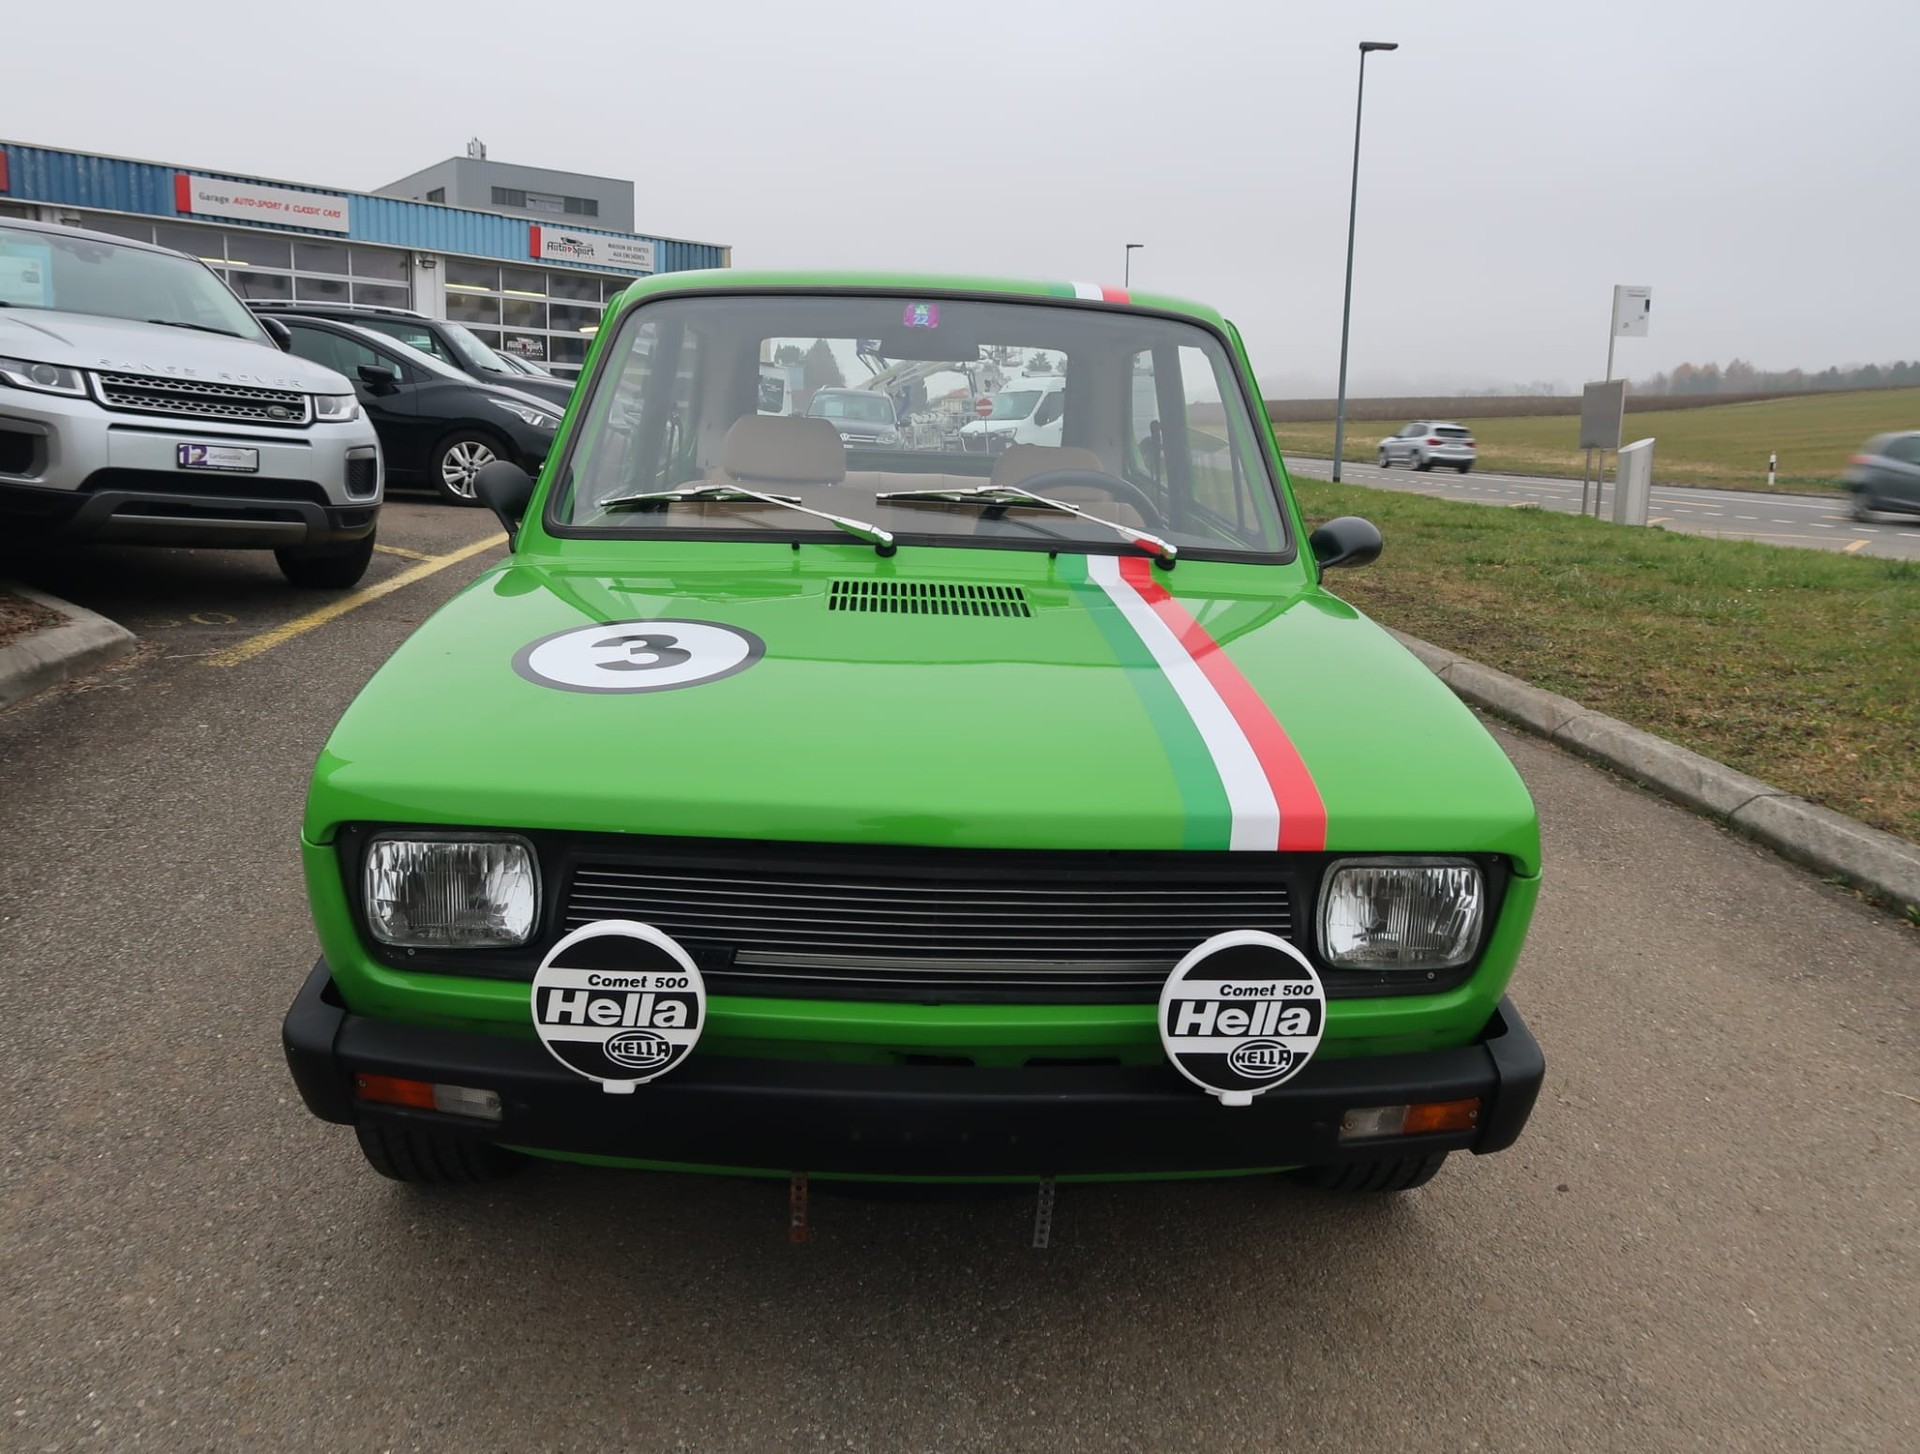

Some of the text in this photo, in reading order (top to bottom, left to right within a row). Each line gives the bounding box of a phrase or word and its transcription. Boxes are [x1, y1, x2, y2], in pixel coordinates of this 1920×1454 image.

[198, 191, 229, 204] Garage
[233, 197, 282, 211] AUTO-SPORT
[293, 204, 321, 217] CLASSIC
[323, 208, 341, 218] CARS
[99, 358, 303, 389] RANGE ROVER
[179, 444, 207, 466] 12
[591, 633, 692, 671] 3
[588, 974, 689, 988] Comet 500
[1219, 984, 1314, 996] Comet 500
[545, 989, 688, 1028] Hella
[1174, 1001, 1311, 1036] Hella
[611, 1041, 671, 1058] HELLA
[1235, 1050, 1292, 1066] HELLA
